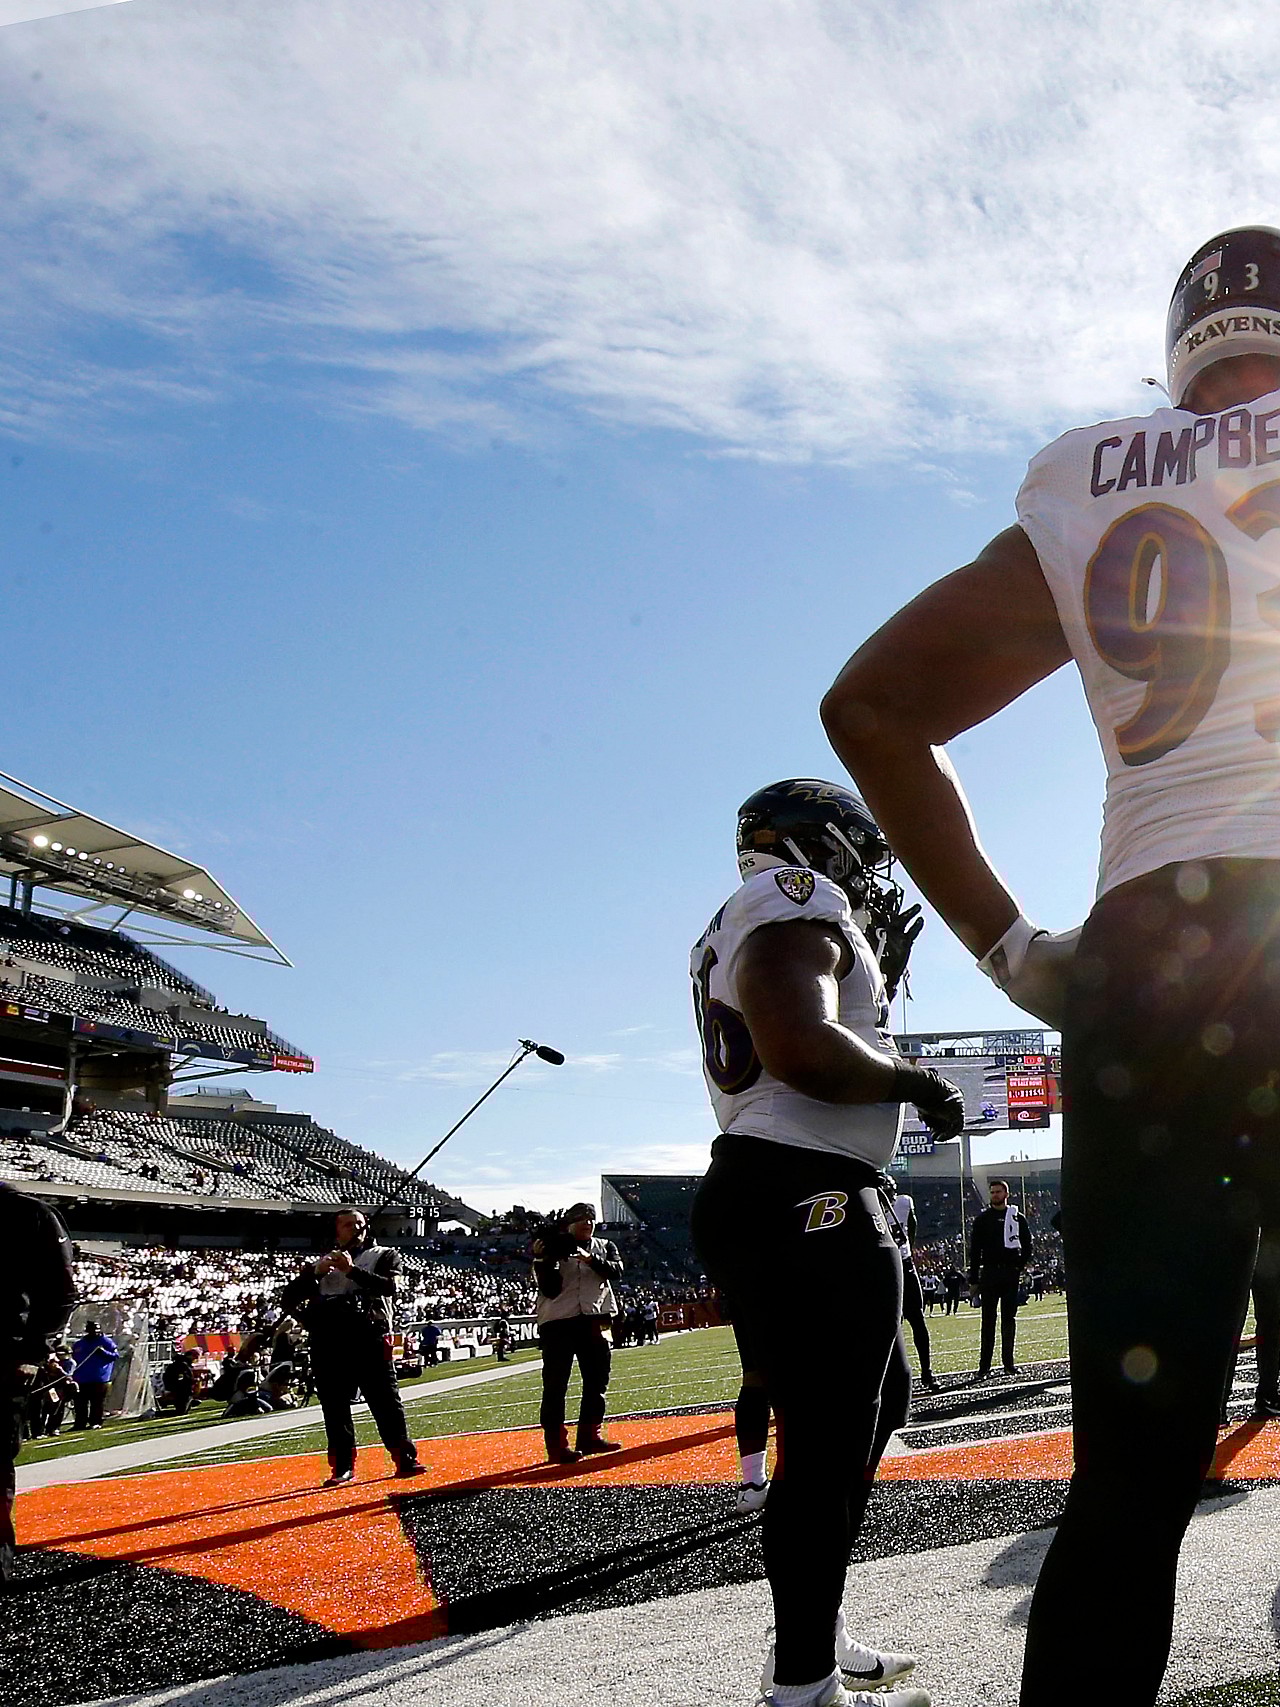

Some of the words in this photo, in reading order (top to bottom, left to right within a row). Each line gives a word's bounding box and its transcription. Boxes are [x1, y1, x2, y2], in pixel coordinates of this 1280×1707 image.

[901, 1135, 928, 1145] BUD
[897, 1143, 933, 1154] LIGHT
[409, 1206, 440, 1218] 39:15
[793, 1191, 848, 1233] B
